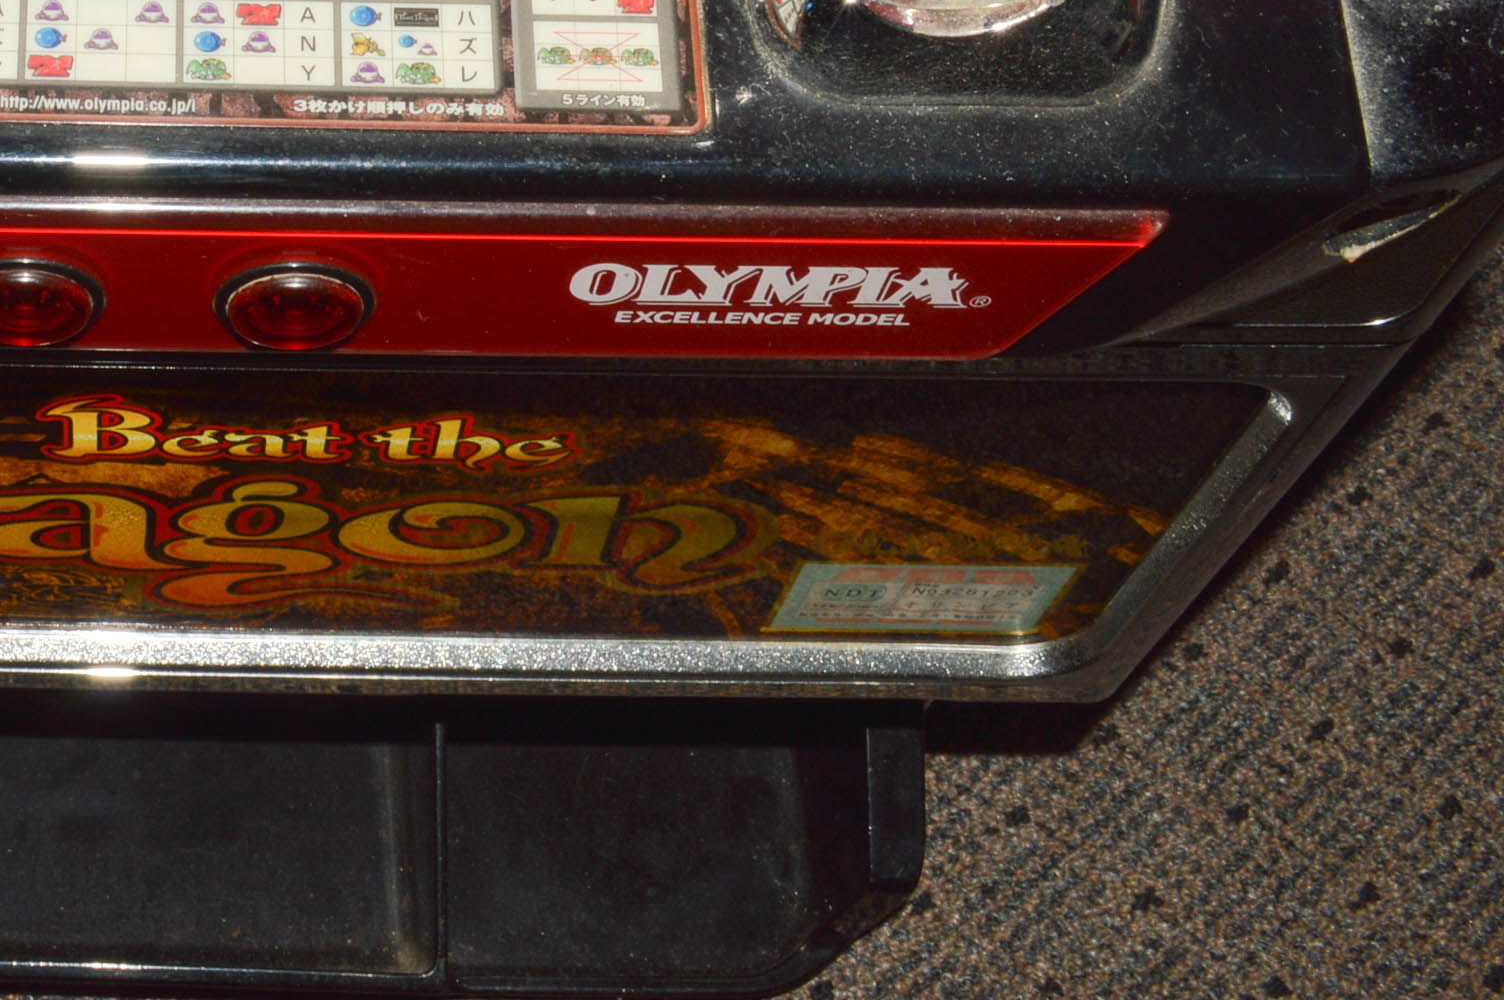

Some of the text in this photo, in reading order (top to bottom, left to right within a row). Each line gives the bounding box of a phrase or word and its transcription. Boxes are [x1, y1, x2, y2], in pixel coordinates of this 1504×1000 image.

[569, 262, 970, 309] OLYMPIA
[614, 309, 910, 327] EXCELLENCE MODEL
[44, 398, 582, 474] Beat the
